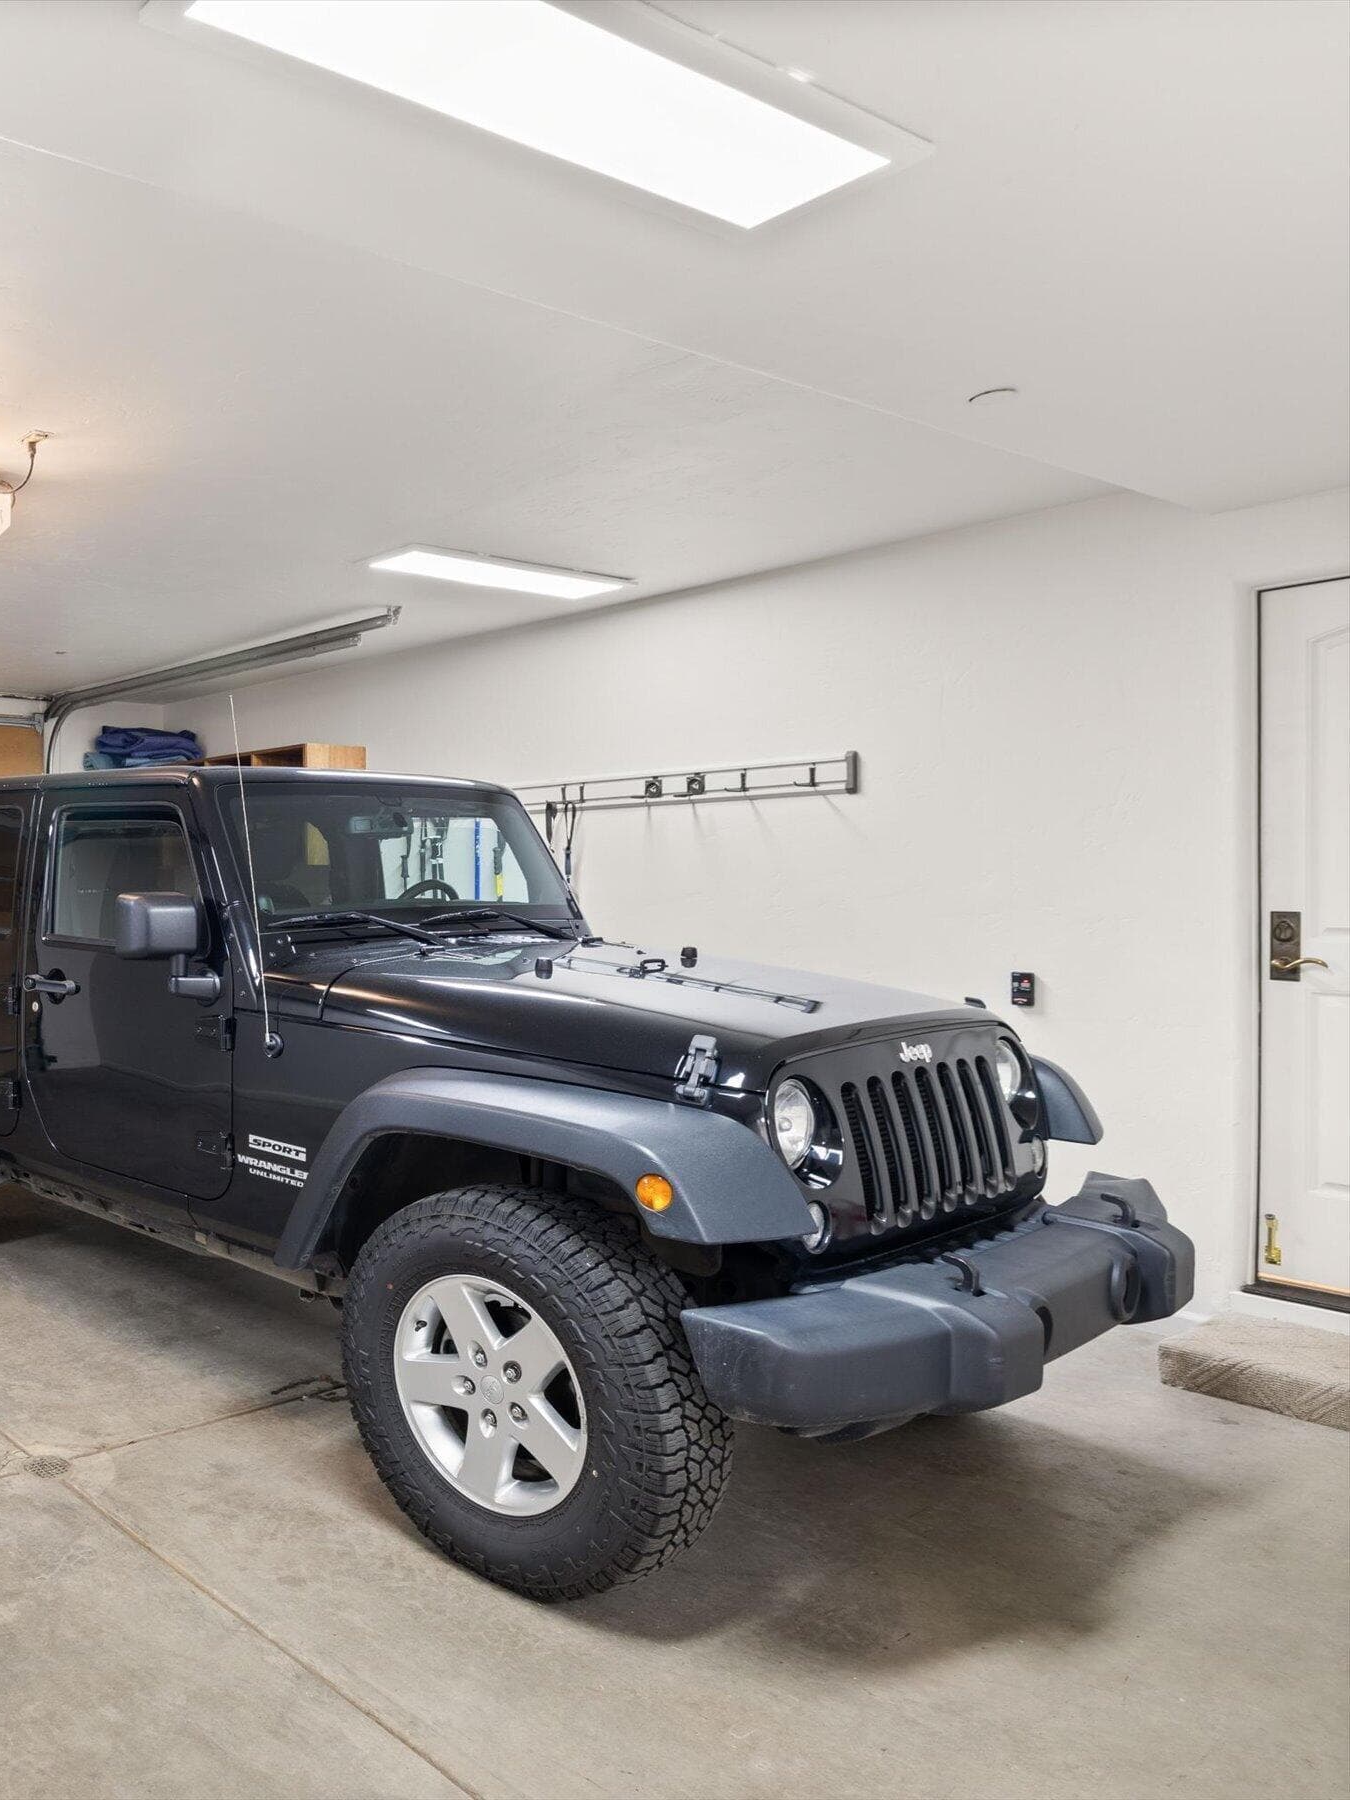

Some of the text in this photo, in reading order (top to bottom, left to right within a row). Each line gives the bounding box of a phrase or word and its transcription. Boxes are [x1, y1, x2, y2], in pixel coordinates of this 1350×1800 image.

[899, 1041, 933, 1063] Jeep
[251, 1138, 301, 1157] SPORT
[237, 1153, 309, 1180] WRANGLER
[249, 1168, 304, 1188] UNLIMITED
